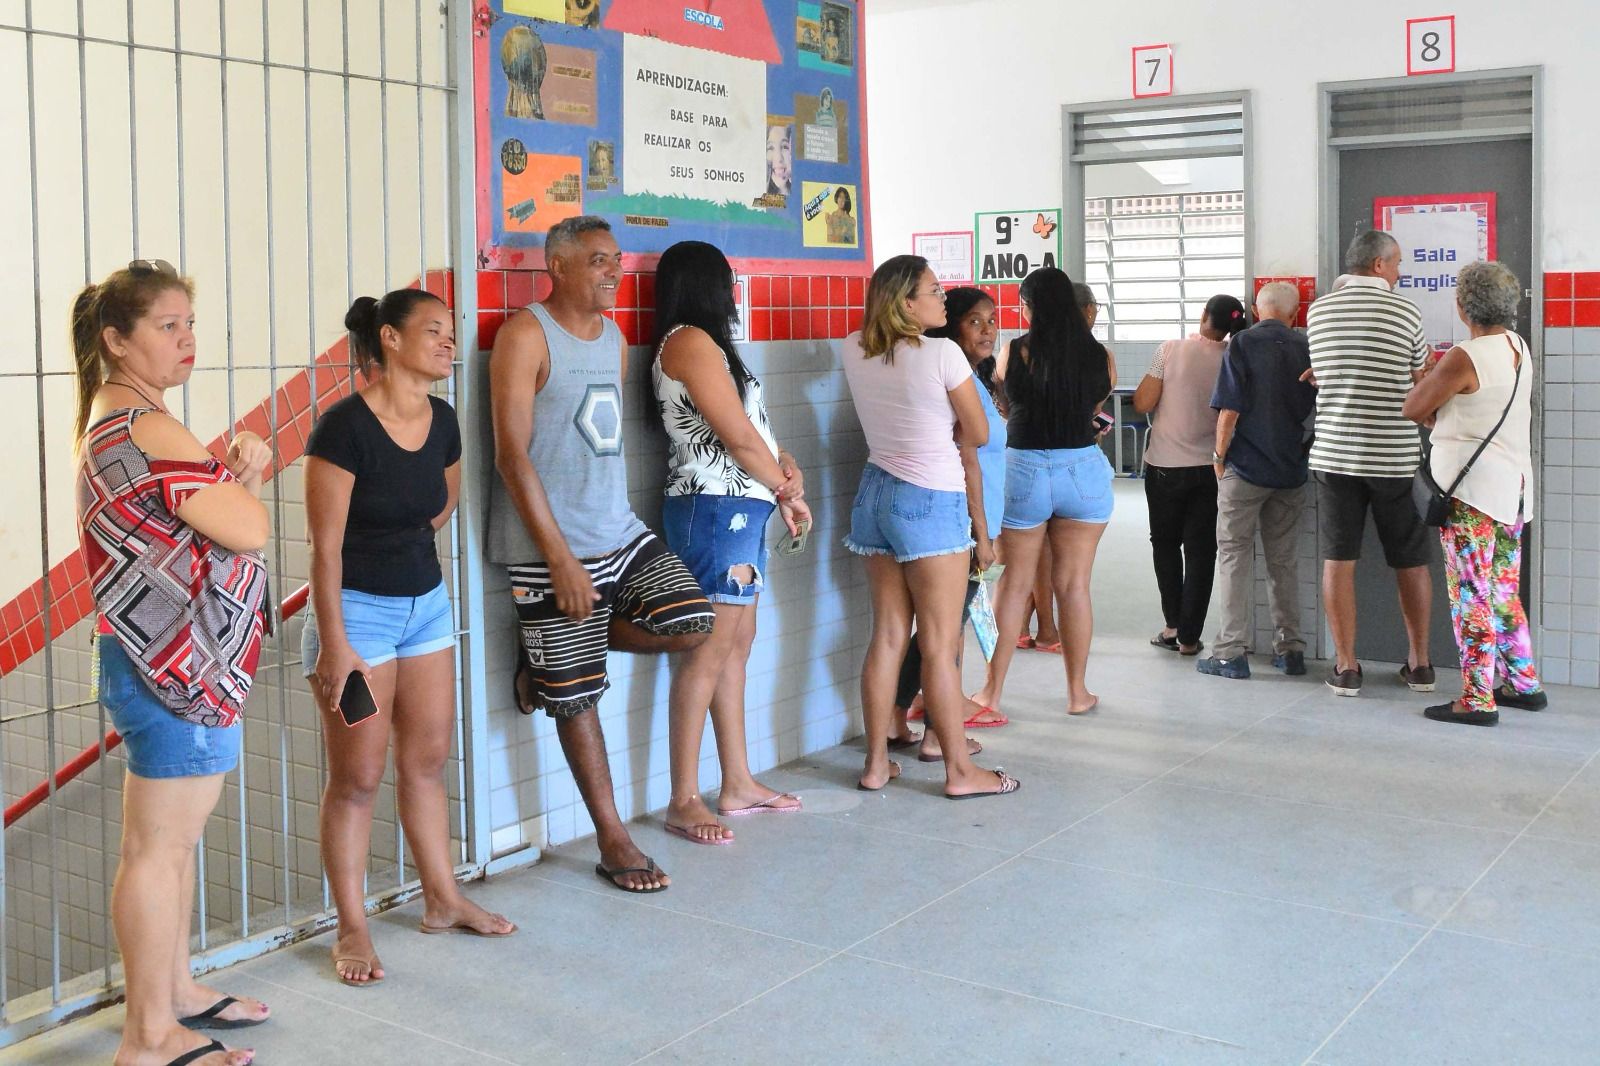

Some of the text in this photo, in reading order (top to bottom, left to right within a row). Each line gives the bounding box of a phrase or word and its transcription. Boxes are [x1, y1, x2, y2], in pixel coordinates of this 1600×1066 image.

[685, 8, 723, 29] ESCOLA
[1420, 31, 1442, 62] 8
[1144, 58, 1161, 87] 7
[636, 68, 729, 98] APRENDIZAGEM:
[670, 108, 728, 128] BASE PARA
[644, 133, 712, 153] REALIZAR OS
[670, 165, 745, 183] SEUS SONHOS
[1413, 248, 1457, 262] Sala
[982, 252, 1055, 279] ANO-A
[1399, 274, 1458, 292] Englis
[522, 629, 543, 639] ANG
